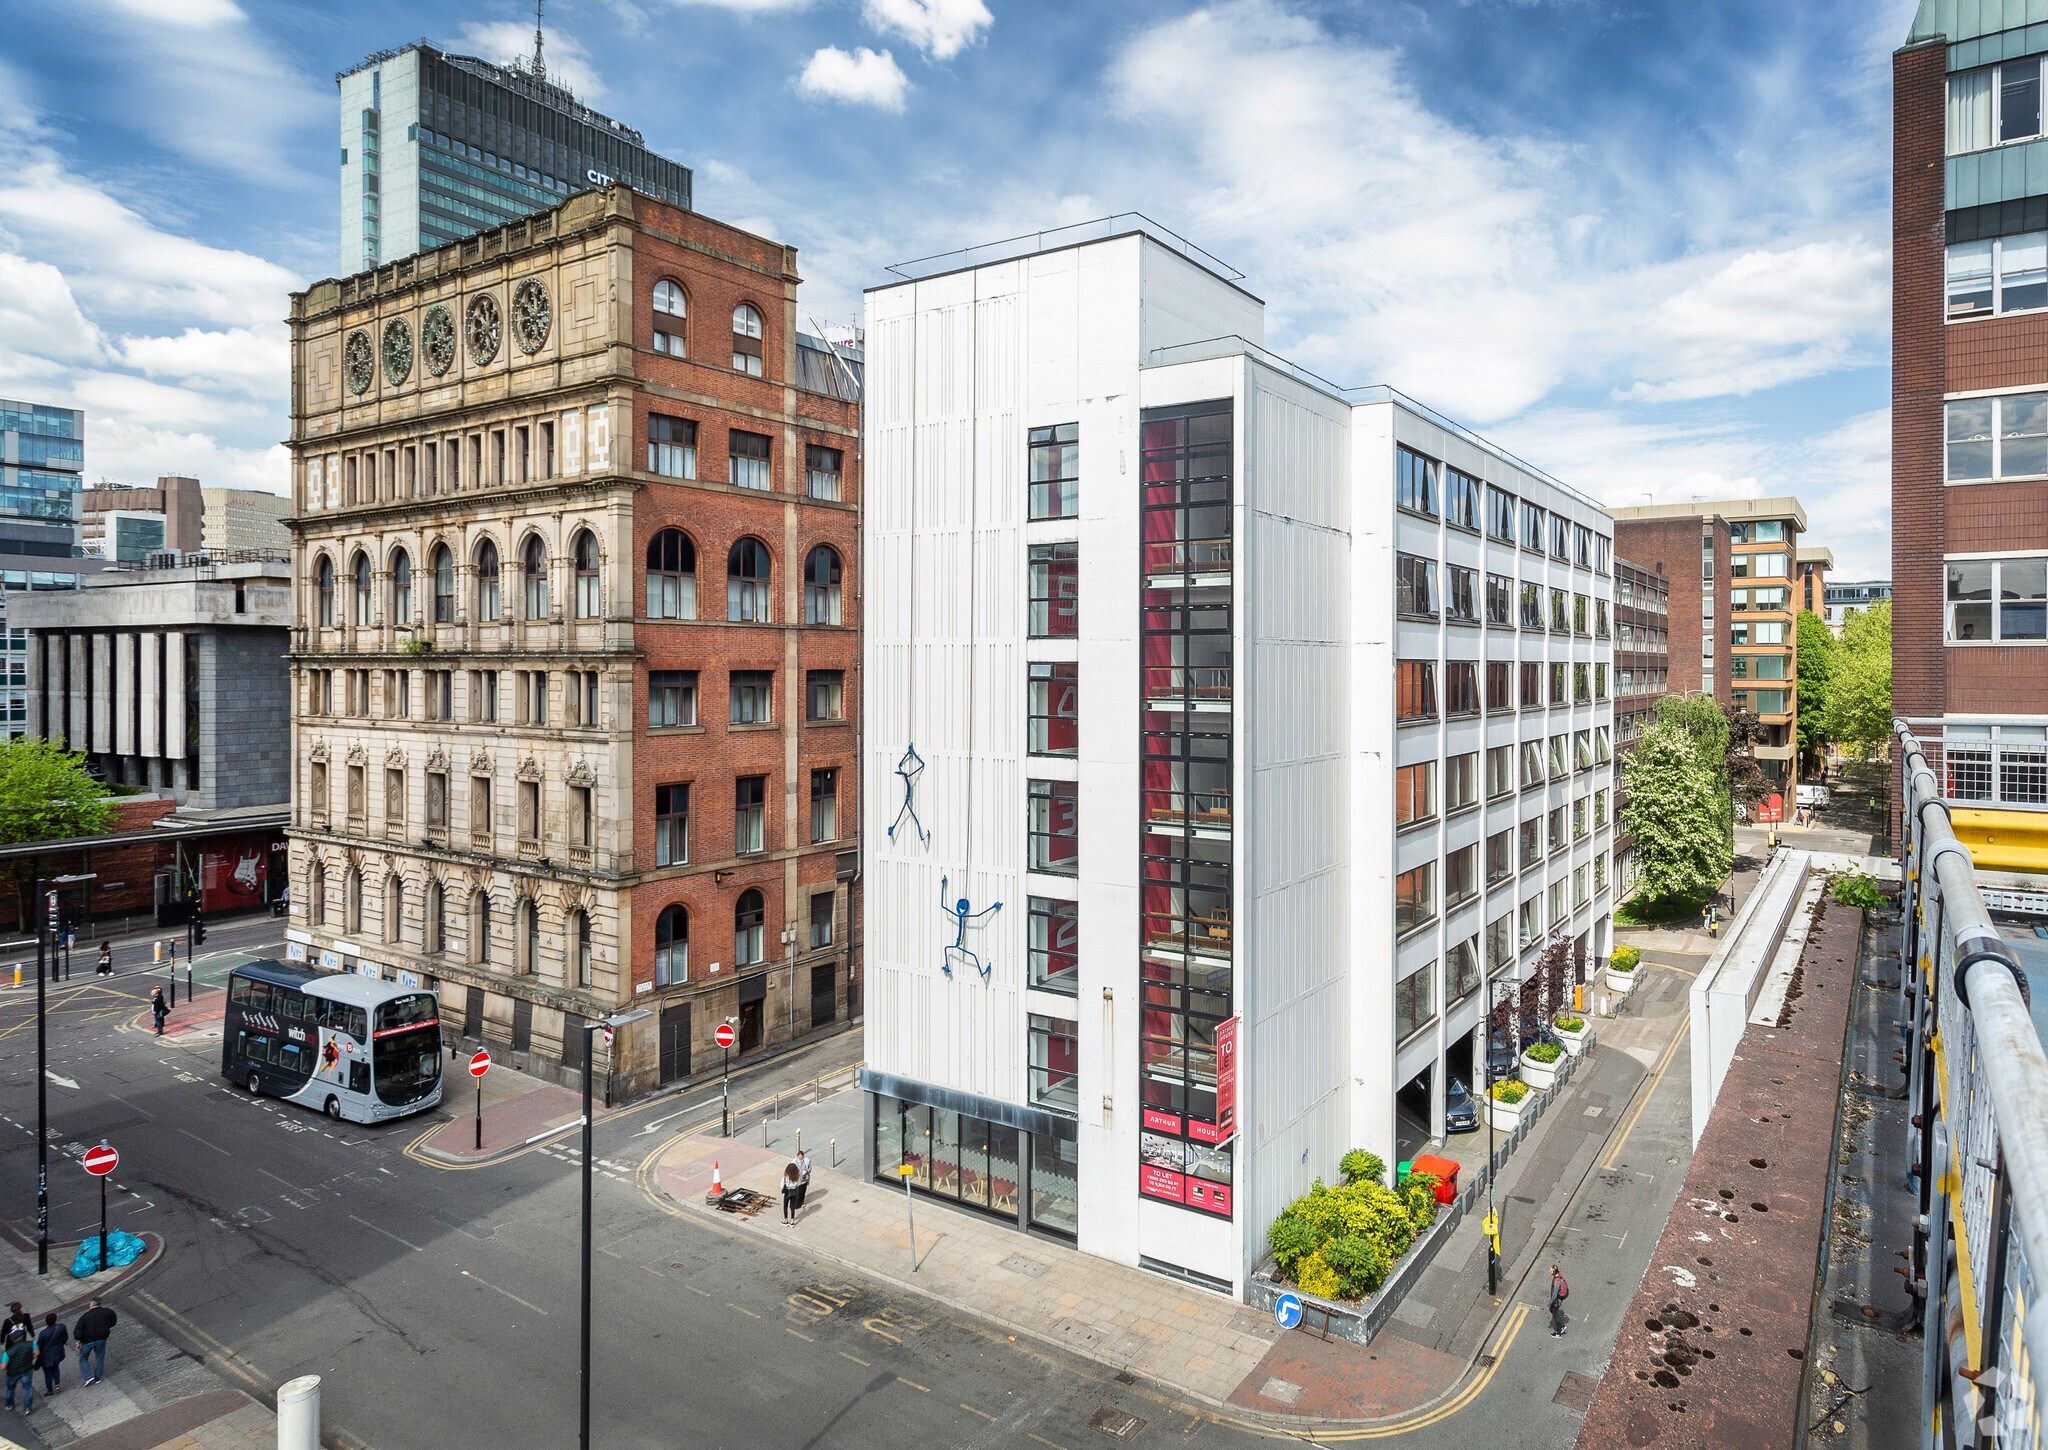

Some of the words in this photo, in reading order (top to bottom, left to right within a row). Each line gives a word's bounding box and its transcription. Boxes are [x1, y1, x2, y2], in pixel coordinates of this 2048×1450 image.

[1221, 1041, 1232, 1057] TO
[1149, 1116, 1176, 1128] ARTHUR
[1196, 1127, 1217, 1137] HOUS
[1153, 1169, 1161, 1177] TO
[1162, 1172, 1173, 1180] LET
